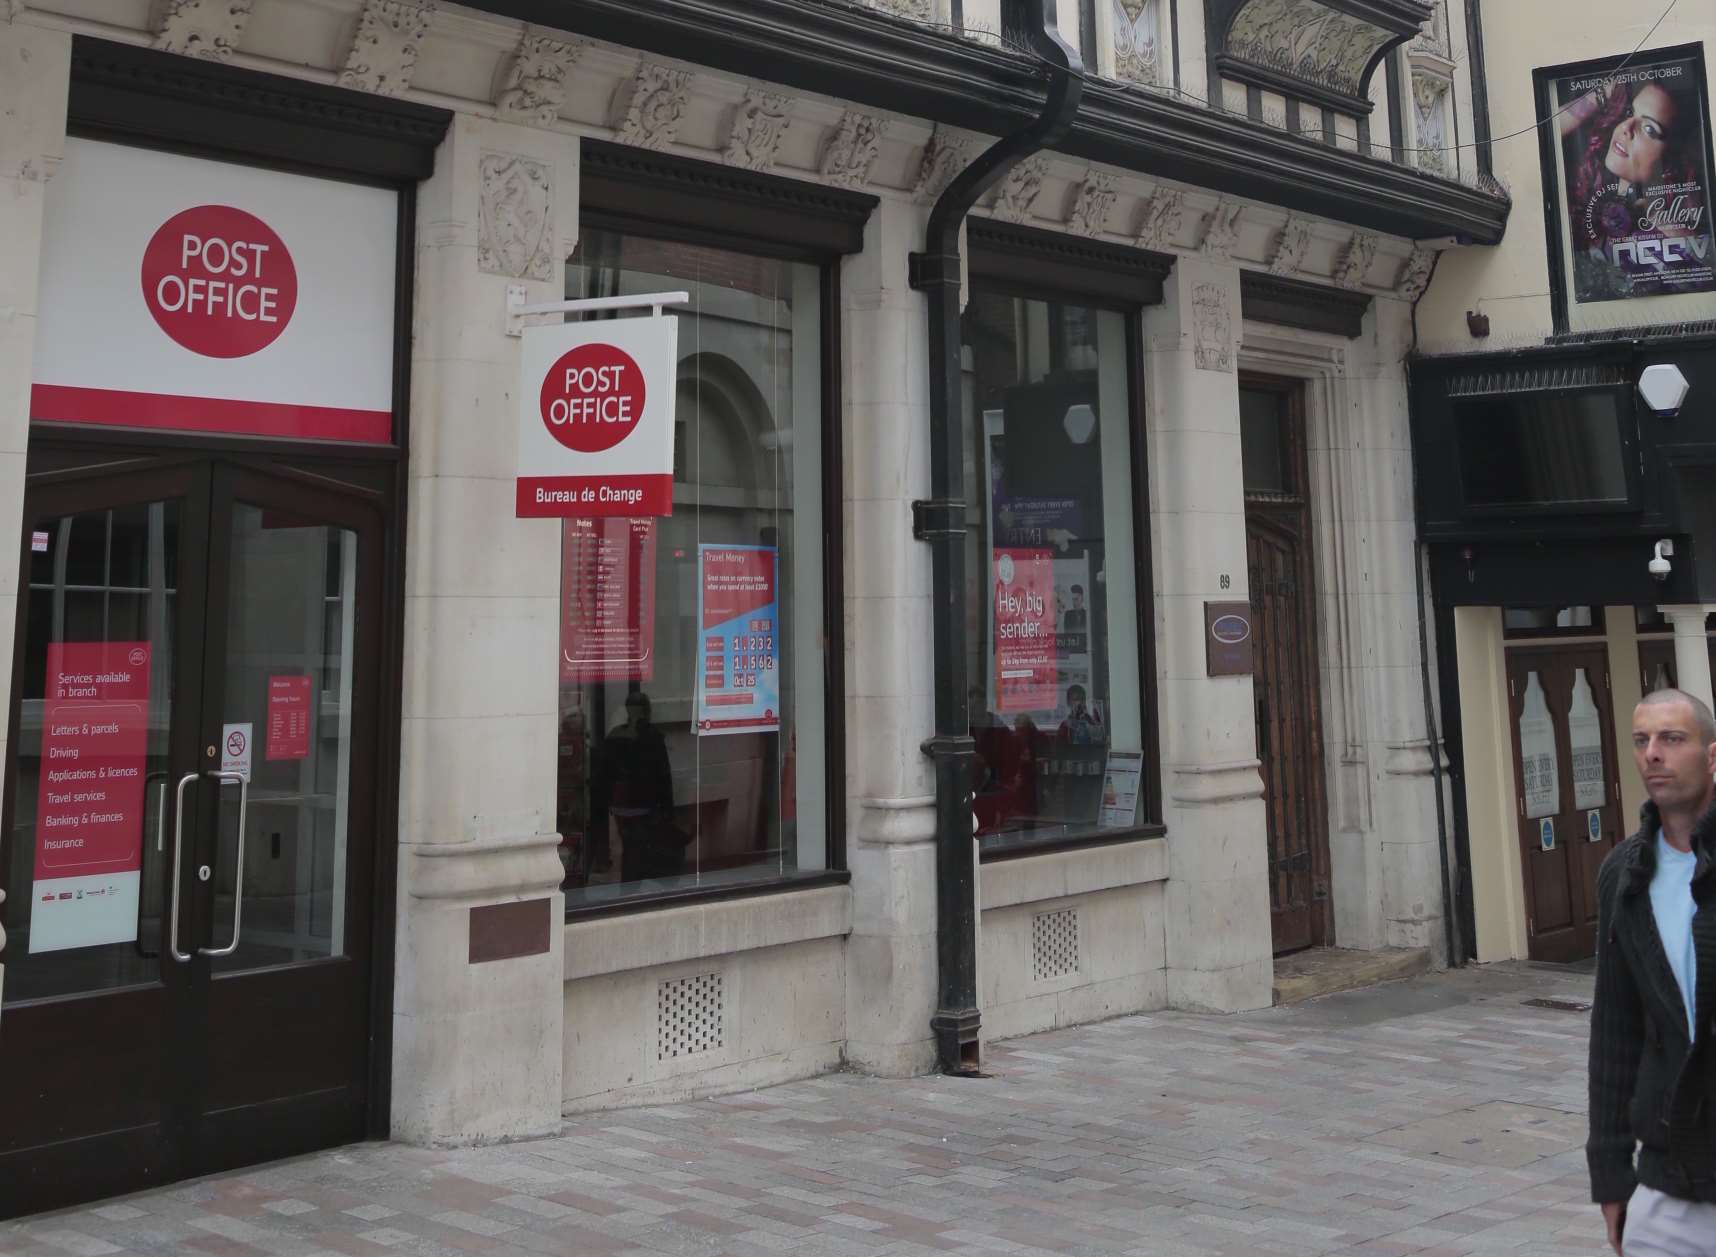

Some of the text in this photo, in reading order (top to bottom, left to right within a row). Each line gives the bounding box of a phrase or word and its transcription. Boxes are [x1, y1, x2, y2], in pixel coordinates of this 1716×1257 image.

[1570, 66, 1683, 91] SATURDAY 25TH OCTOBER
[1637, 195, 1704, 231] Gallery
[181, 234, 269, 278] POST
[157, 275, 278, 322] OFFICE
[565, 365, 625, 394] POST
[550, 395, 632, 425] OFFICE
[536, 486, 643, 504] Bureau de Change
[705, 552, 745, 565] Travel Money
[1219, 574, 1231, 590] 89
[998, 592, 1043, 617] Hey, big
[1000, 616, 1048, 639] sender...
[58, 671, 131, 685] Services available
[57, 686, 97, 697] in branch
[51, 722, 119, 736] Letters & parcels
[49, 747, 79, 760] Driving
[48, 766, 138, 783] Applications & licences
[47, 791, 106, 804] Travel services
[46, 812, 124, 828] Banking & finances
[44, 837, 84, 849] Insurance
